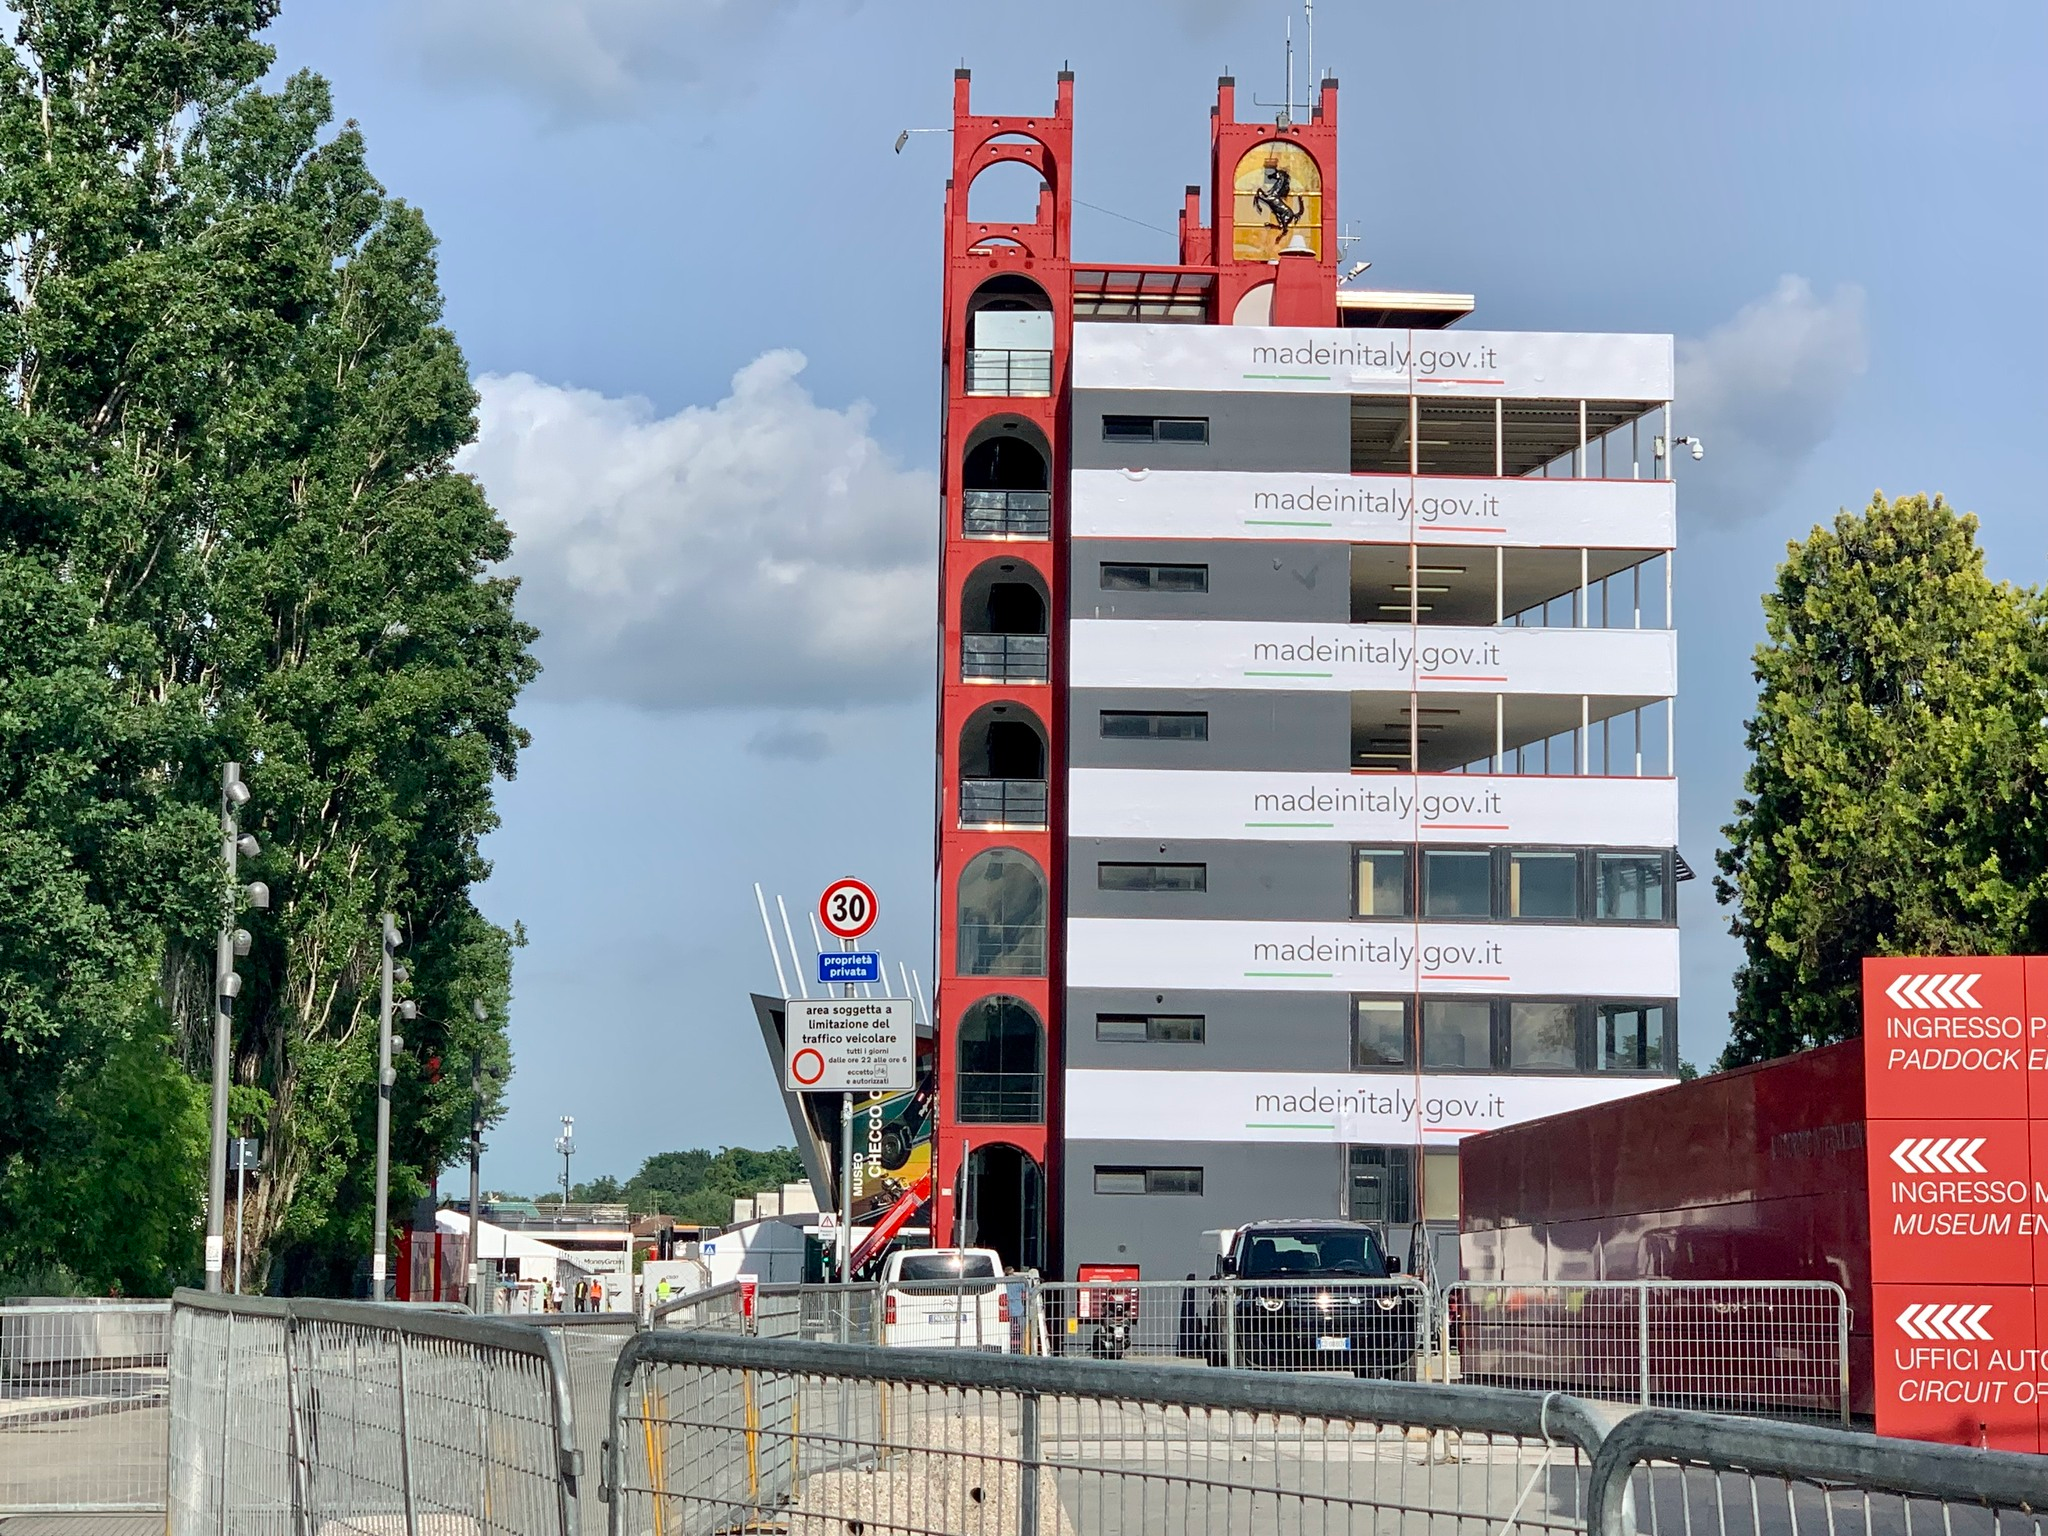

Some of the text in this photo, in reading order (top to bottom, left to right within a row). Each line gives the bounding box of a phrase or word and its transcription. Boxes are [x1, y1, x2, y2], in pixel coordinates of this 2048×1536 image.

[1253, 340, 1497, 374] madeinitaly.gov.it
[1254, 486, 1499, 522] madeinitaly.gov.it
[1254, 636, 1500, 672] madeinitaly.gov.it
[1254, 786, 1501, 820] madeinitaly.gov.it
[832, 894, 865, 922] 30
[824, 955, 872, 967] proprietà
[1254, 936, 1502, 971] madeinitaly.gov.it
[830, 968, 867, 978] privata
[806, 1005, 893, 1017] area soggetta a
[808, 1018, 890, 1030] limitazione del
[1887, 1016, 2048, 1038] INGRESSO P
[802, 1033, 897, 1044] traffico veicolare
[868, 1048, 889, 1056] giorni
[902, 1056, 907, 1064] 6
[1888, 1048, 2048, 1070] PADDOCK E
[1255, 1087, 1505, 1123] madeinitaly.gov.it
[868, 1105, 882, 1178] CHECCO
[853, 1152, 864, 1197] MUSEO
[1892, 1181, 2027, 1203] INGRESSO
[1893, 1213, 2011, 1235] MUSEUM
[1895, 1348, 1978, 1371] UFFICI
[1899, 1380, 2008, 1403] CIRCUIT
